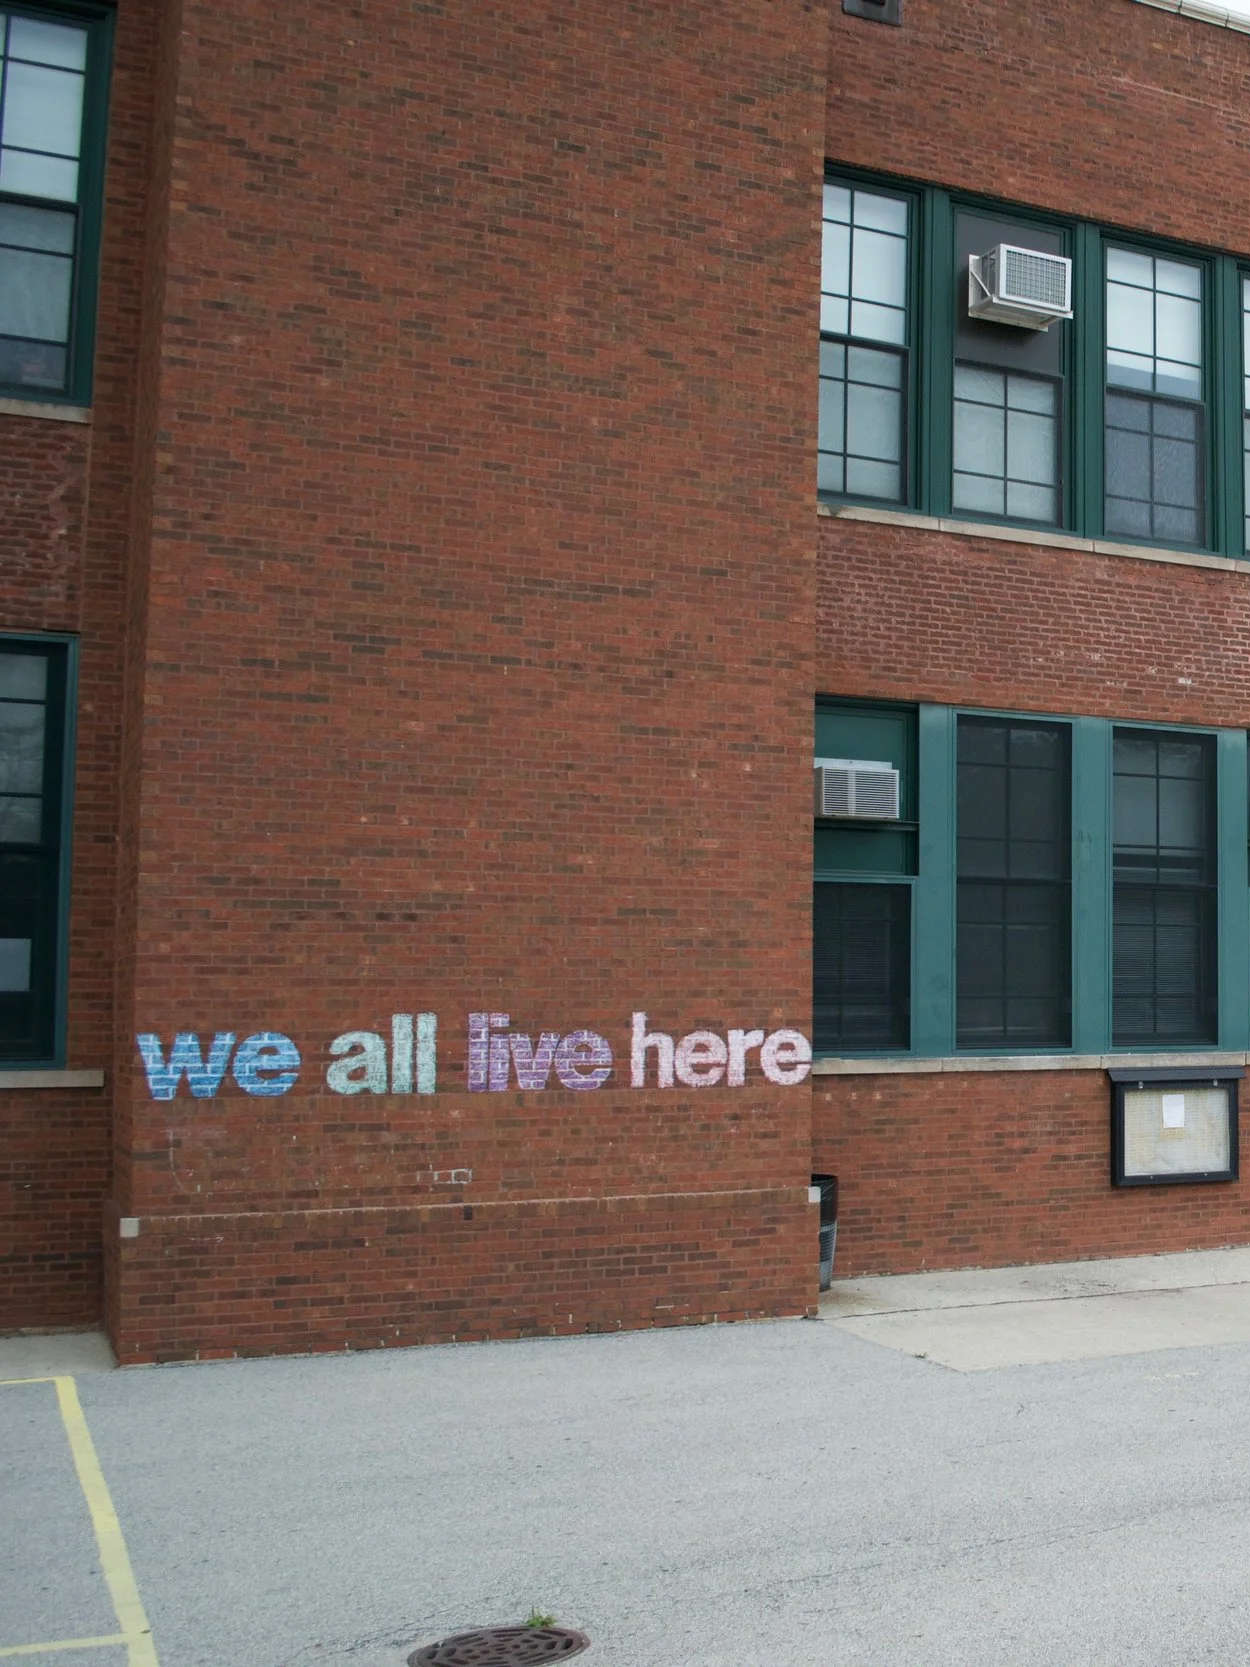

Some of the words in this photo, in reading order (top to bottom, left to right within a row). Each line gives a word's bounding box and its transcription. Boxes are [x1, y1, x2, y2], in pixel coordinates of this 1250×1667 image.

[136, 1031, 302, 1101] we
[326, 1012, 438, 1095] all
[468, 1012, 613, 1093] live
[630, 1011, 813, 1088] here
